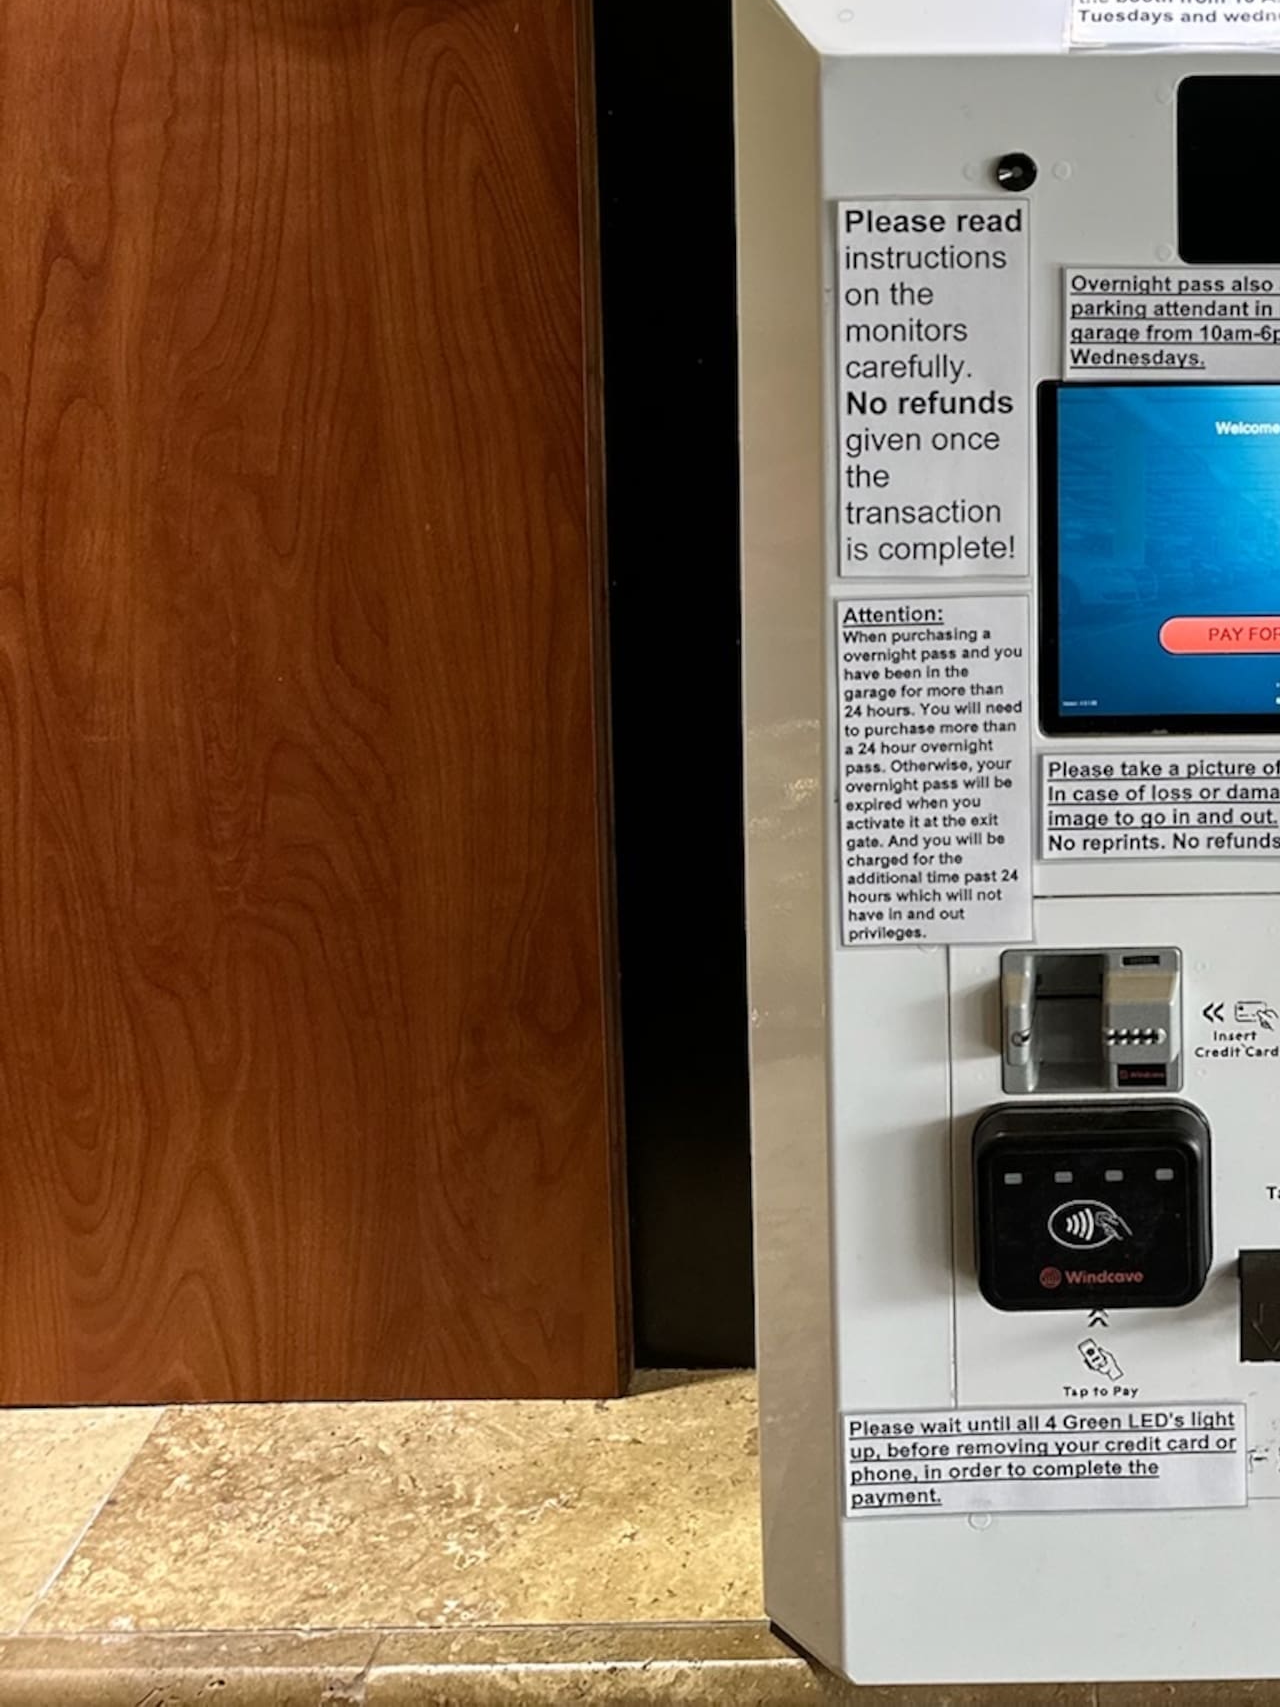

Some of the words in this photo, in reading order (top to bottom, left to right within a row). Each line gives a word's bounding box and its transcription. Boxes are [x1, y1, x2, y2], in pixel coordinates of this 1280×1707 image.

[846, 210, 946, 233] Please
[958, 209, 1021, 232] read
[846, 245, 1007, 270] instructions
[1072, 275, 1171, 292] Overnight
[1178, 280, 1224, 293] pass
[1232, 276, 1273, 293] also
[847, 391, 887, 415] No
[899, 390, 1013, 414] refunds
[1216, 421, 1280, 435] Welcome
[843, 606, 942, 624] Attention:
[1209, 628, 1244, 641] PAY
[1048, 761, 1114, 778] Please
[1120, 760, 1162, 777] take
[1169, 764, 1179, 776] a
[1187, 760, 1256, 776] picture
[1214, 1031, 1256, 1041] Insert
[1194, 1046, 1240, 1058] Credit
[1244, 1046, 1279, 1058] Card
[1065, 1270, 1144, 1284] Windcave
[1063, 1386, 1088, 1398] Tap
[1094, 1387, 1108, 1396] to
[1113, 1386, 1138, 1398] Pay
[850, 1421, 914, 1436] Please
[920, 1418, 962, 1434] wait
[968, 1416, 1010, 1432] until
[1017, 1416, 1038, 1431] all
[1045, 1416, 1057, 1430] 4
[1062, 1414, 1121, 1430] Green
[1129, 1412, 1184, 1429] LED's
[1192, 1411, 1234, 1427] light
